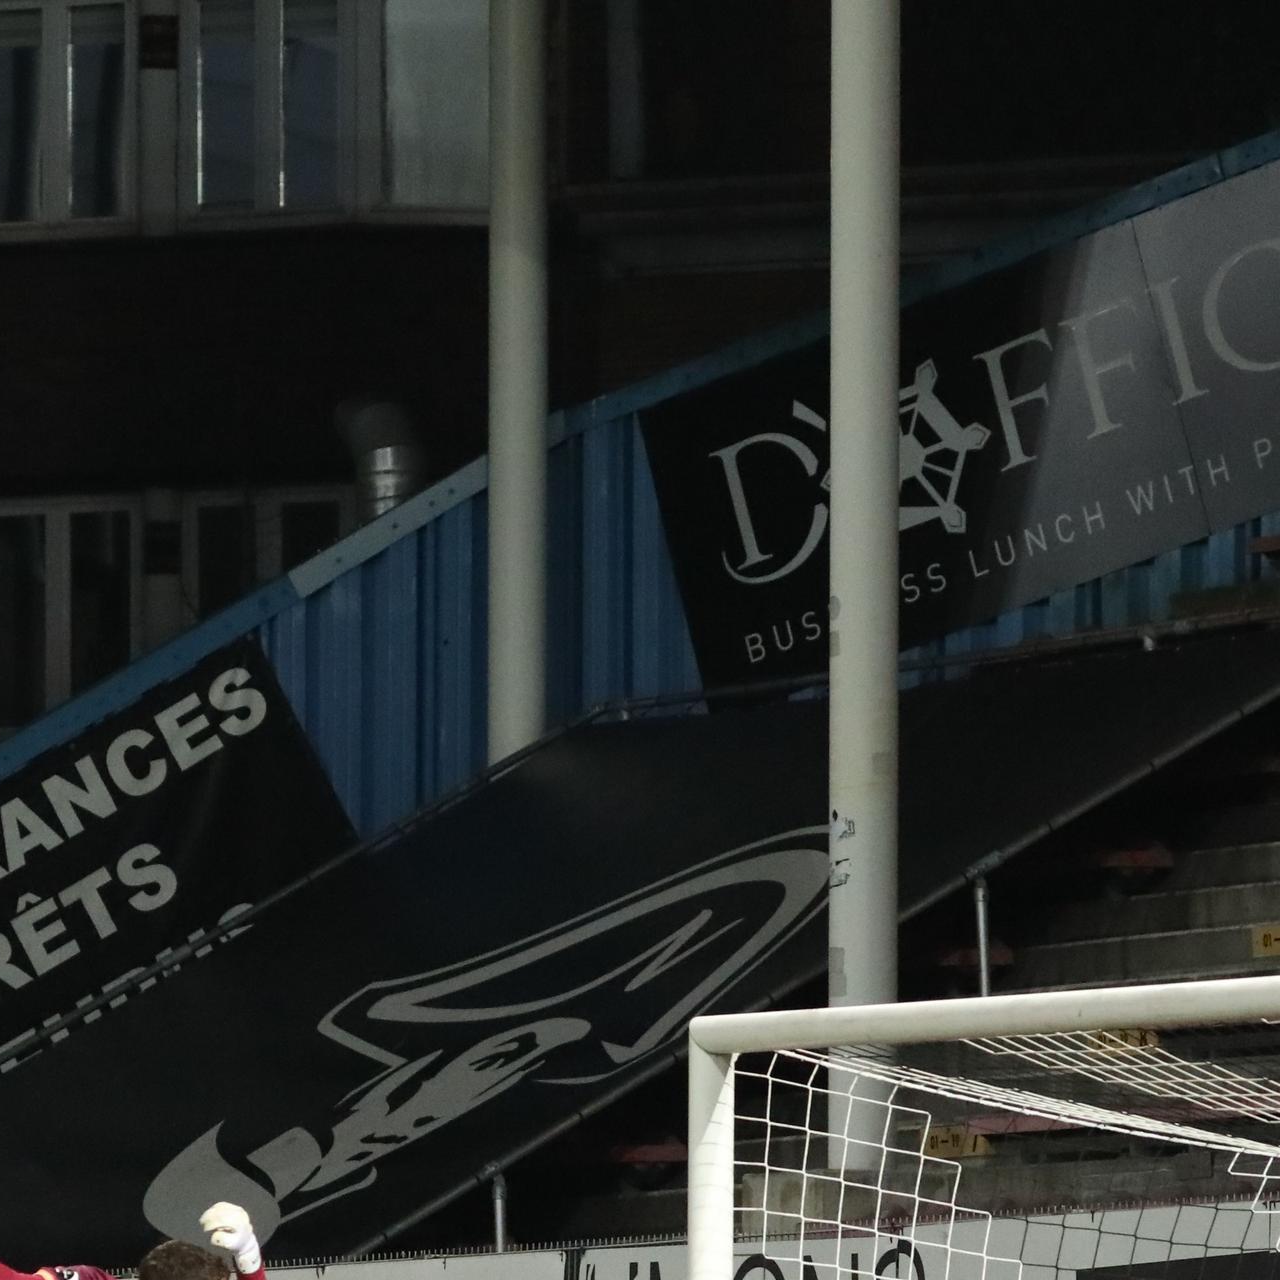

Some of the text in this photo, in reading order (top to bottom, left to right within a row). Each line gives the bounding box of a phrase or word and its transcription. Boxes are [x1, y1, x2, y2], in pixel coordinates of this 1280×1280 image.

[745, 563, 948, 664] BUSSS
[969, 501, 1107, 577] LUNCH
[1126, 459, 1231, 518] WITH
